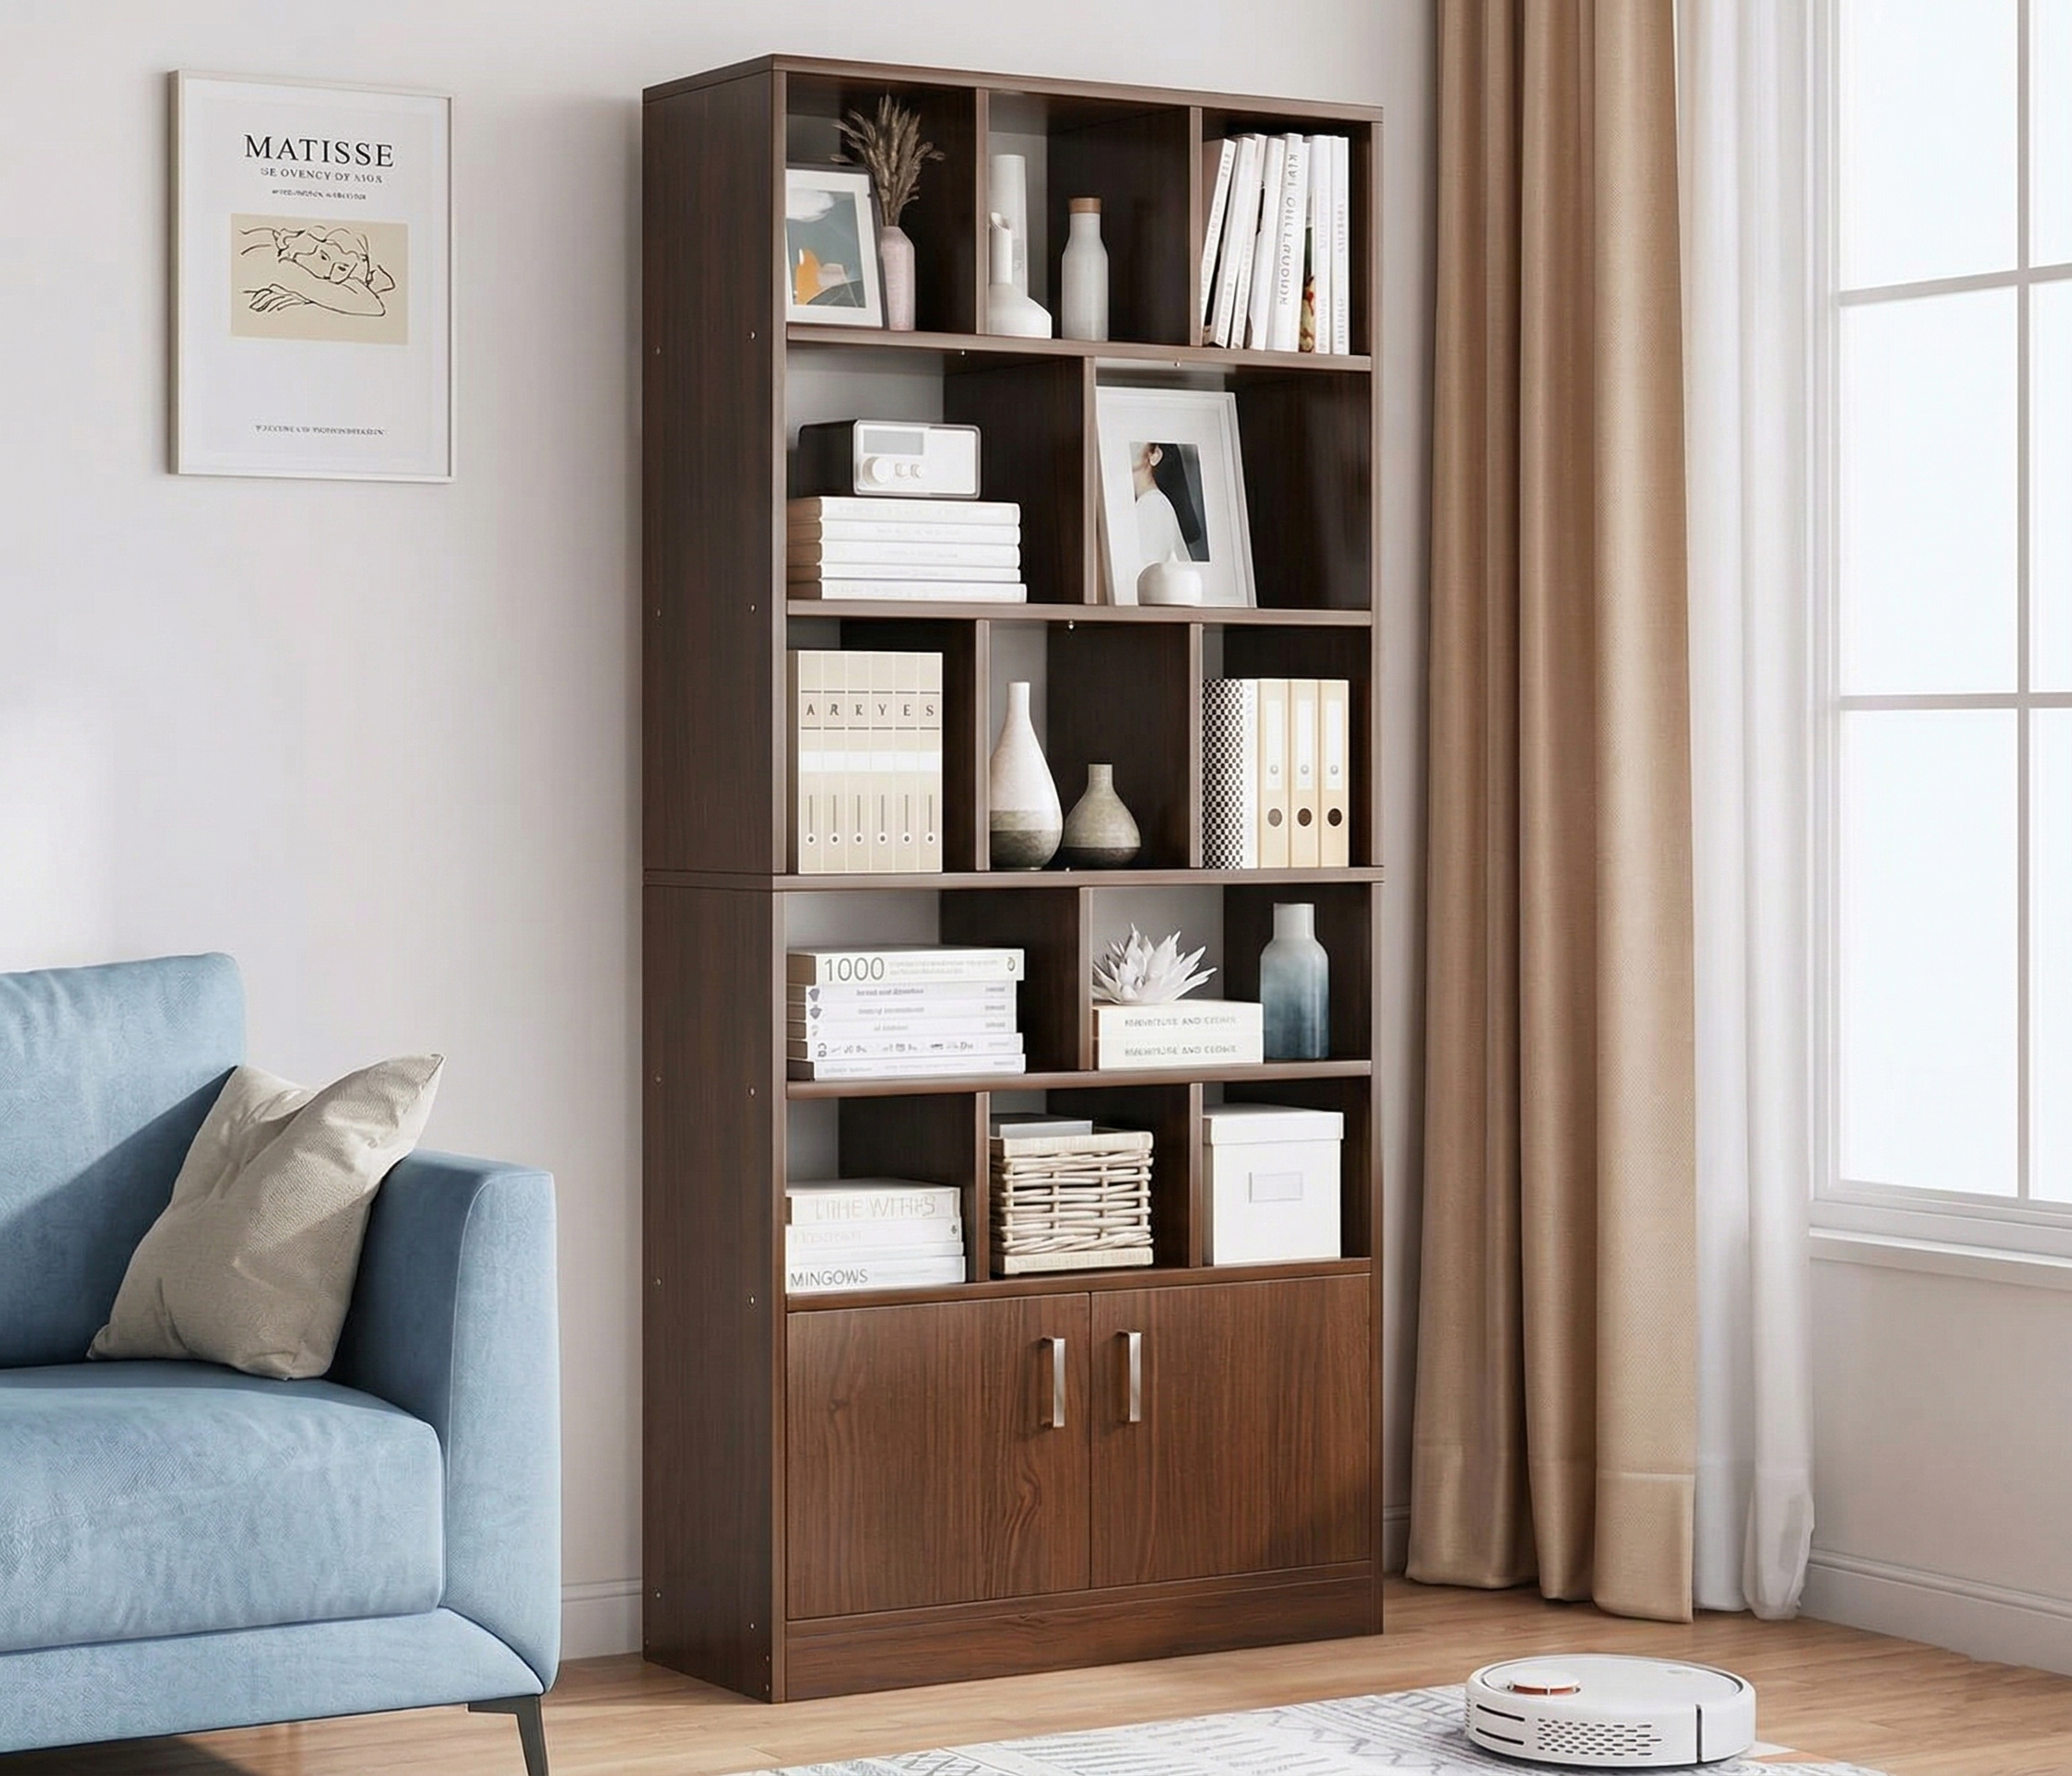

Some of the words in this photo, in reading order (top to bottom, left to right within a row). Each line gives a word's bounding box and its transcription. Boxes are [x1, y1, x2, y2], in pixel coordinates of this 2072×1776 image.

[244, 134, 394, 167] MATISSE
[824, 956, 885, 982] 1000
[791, 1268, 869, 1287] MINGOWS
